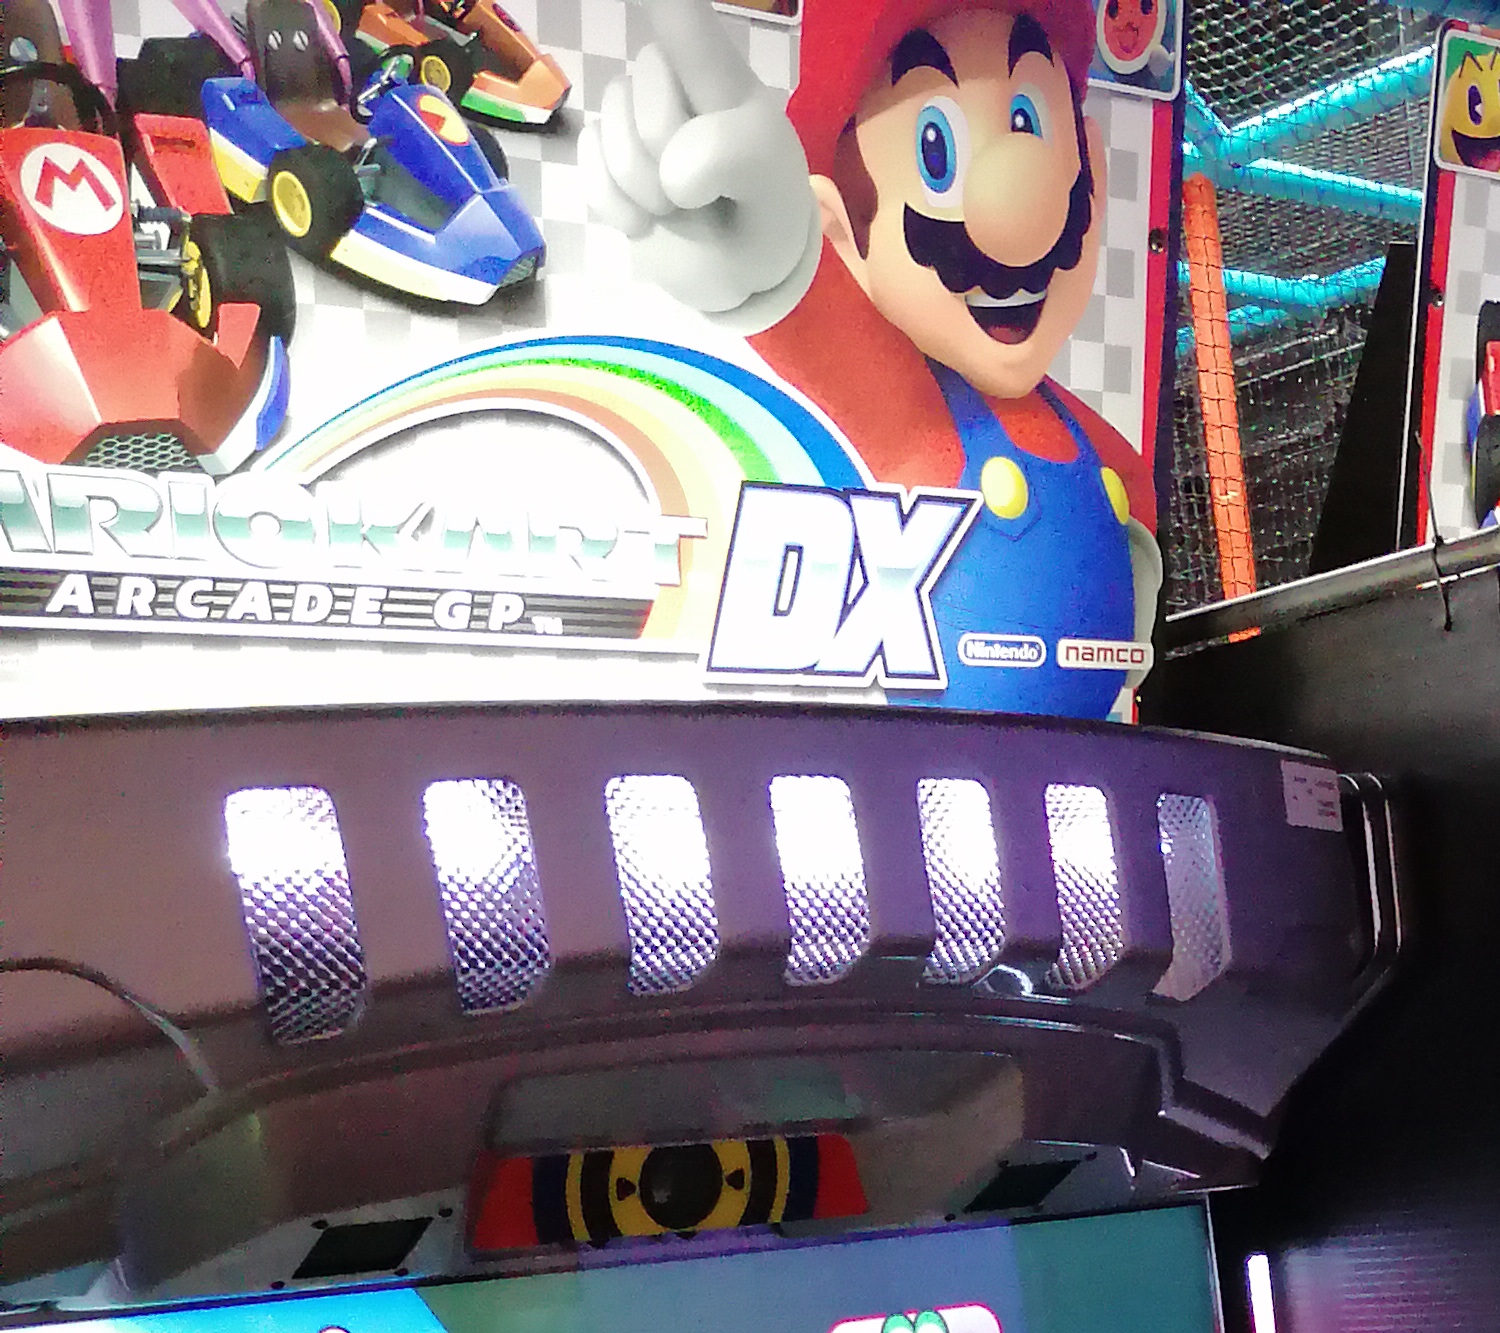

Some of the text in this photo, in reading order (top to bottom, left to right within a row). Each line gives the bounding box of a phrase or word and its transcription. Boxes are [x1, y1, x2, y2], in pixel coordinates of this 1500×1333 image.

[706, 481, 981, 680] DX
[45, 573, 389, 628] ARCADE
[432, 589, 526, 632] GP
[963, 637, 1042, 663] Nintendo
[1064, 644, 1146, 665] namco
